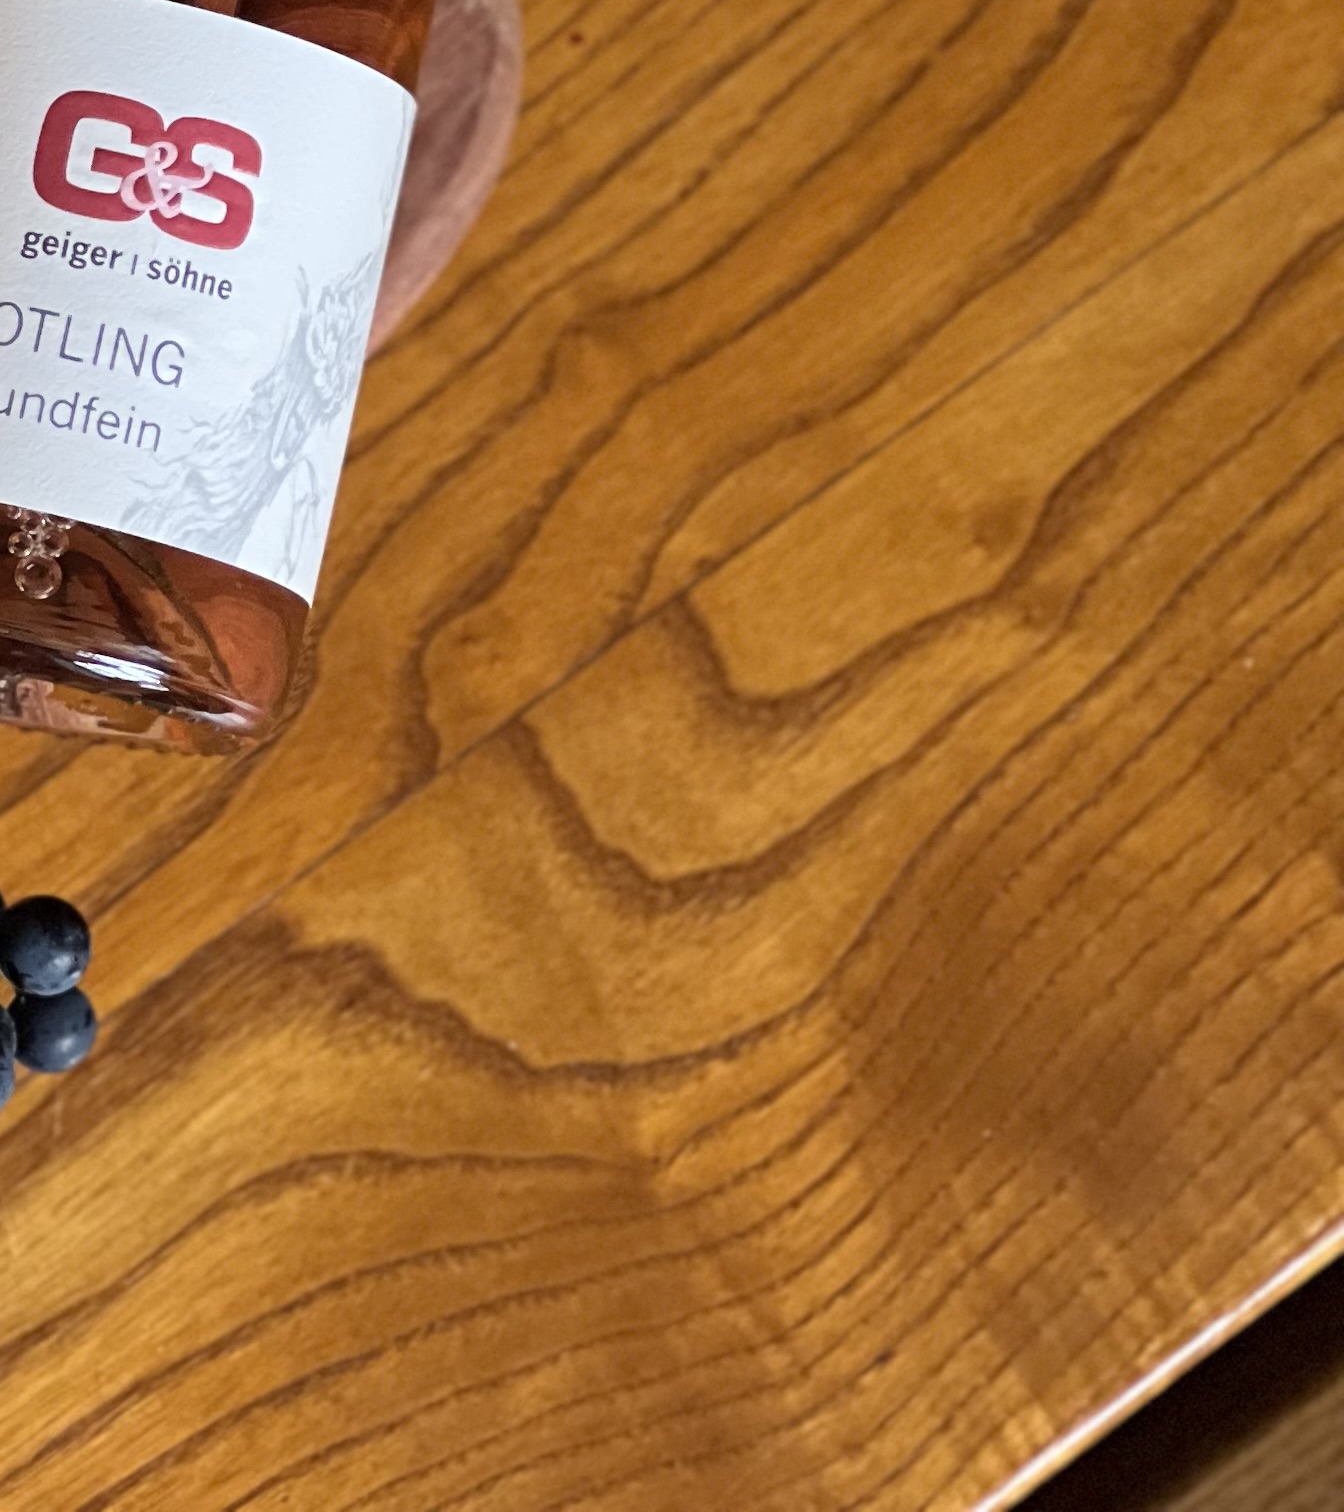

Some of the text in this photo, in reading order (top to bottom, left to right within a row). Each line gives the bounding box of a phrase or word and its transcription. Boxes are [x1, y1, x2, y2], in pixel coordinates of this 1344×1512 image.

[31, 89, 264, 251] G&S
[20, 229, 124, 271] geiger
[146, 258, 234, 300] söhne
